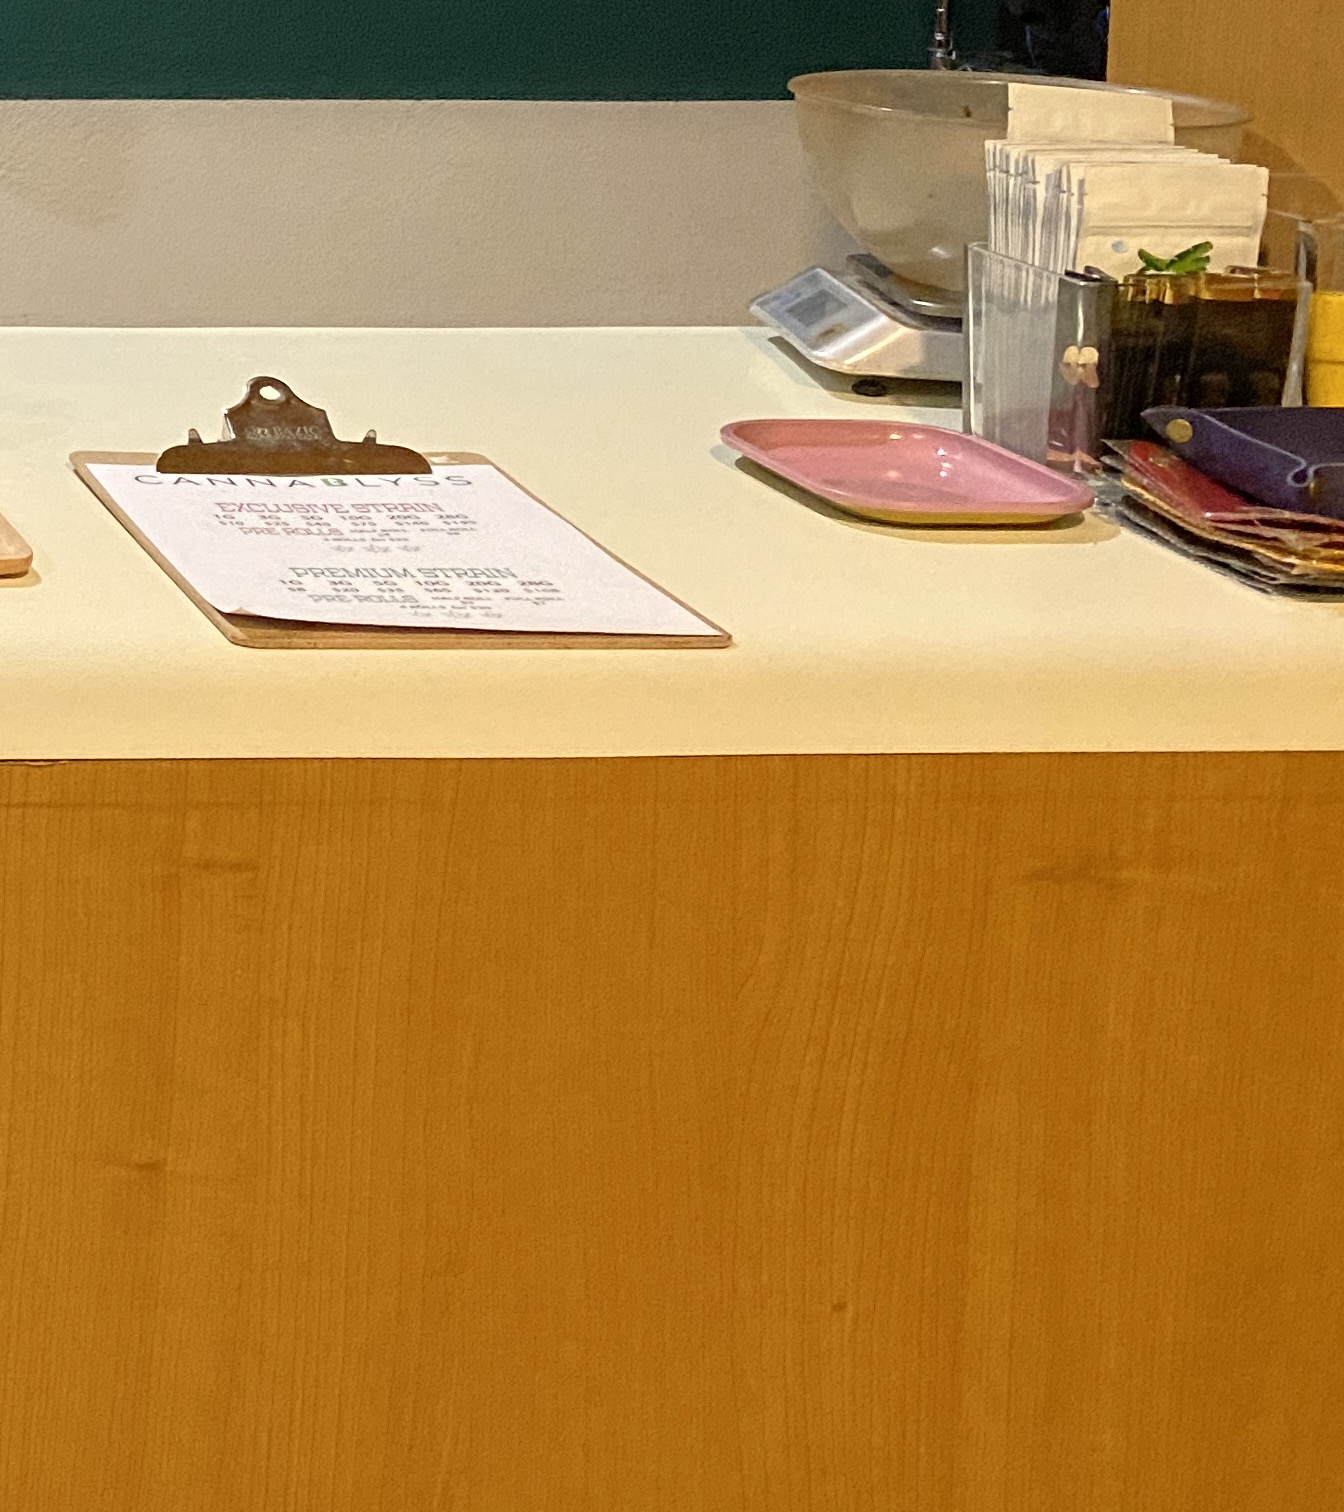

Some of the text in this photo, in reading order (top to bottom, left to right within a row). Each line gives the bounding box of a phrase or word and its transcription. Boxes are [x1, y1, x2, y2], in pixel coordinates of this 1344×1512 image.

[133, 474, 472, 488] CANNABLYSS
[215, 502, 446, 514] EXCLUSIVE STRAIN
[238, 527, 281, 536] PRE
[282, 527, 344, 536] ROLLS
[288, 567, 519, 579] PREMIUM STRAIN
[308, 594, 352, 603] PRE
[353, 594, 419, 604] ROLLS
